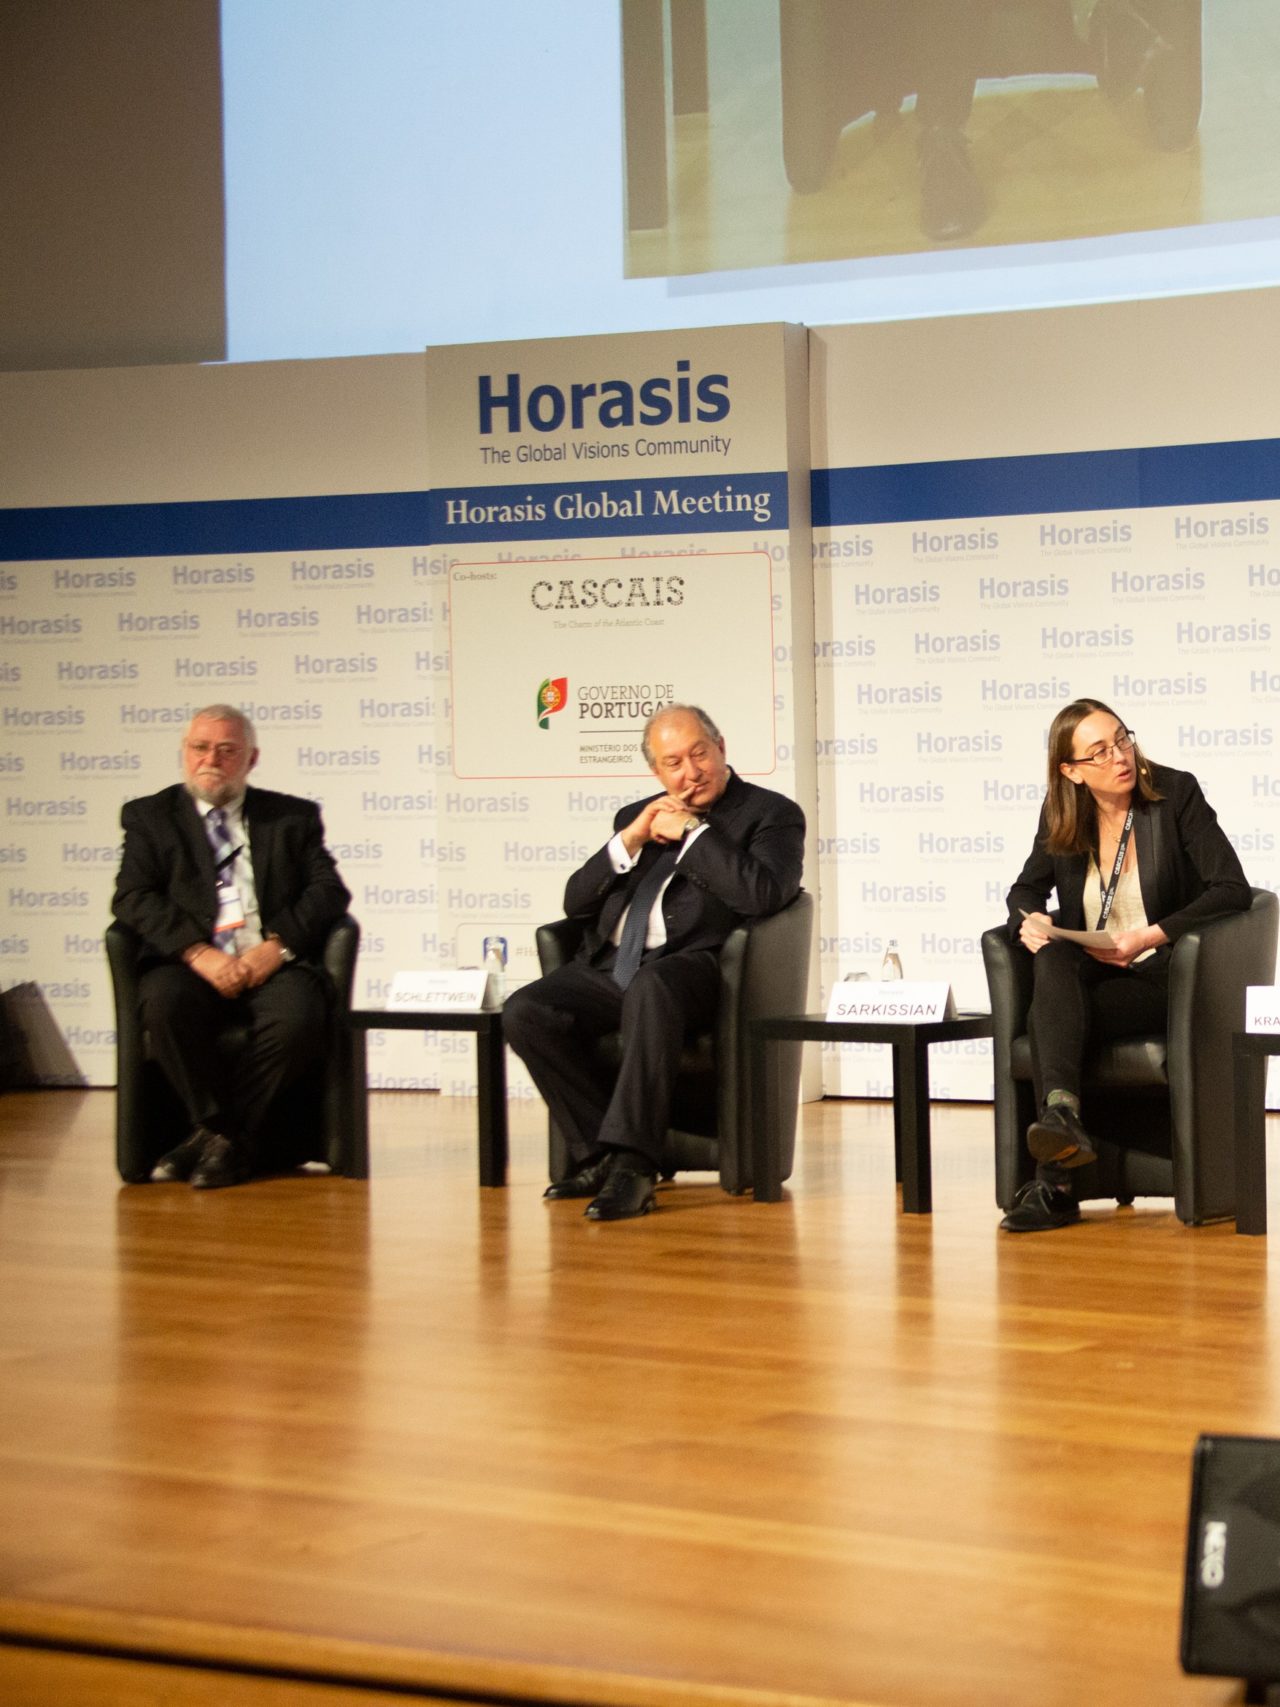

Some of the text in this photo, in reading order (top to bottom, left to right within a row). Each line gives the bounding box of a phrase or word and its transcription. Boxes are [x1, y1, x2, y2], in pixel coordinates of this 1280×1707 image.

[478, 360, 731, 434] Horasis
[480, 435, 732, 464] The Global Visions Community
[446, 486, 771, 525] Horasis Global Meeting
[1040, 521, 1132, 546] Horasis
[1174, 513, 1269, 539] Horasis
[912, 529, 999, 553] Horasis
[54, 571, 136, 589] Horasis
[173, 567, 255, 585] Horasis
[291, 562, 375, 580] Horasis
[453, 571, 497, 582] Co-hosts:
[1111, 567, 1205, 593] Horasis
[530, 575, 685, 611] CASCAIS
[854, 580, 940, 605] Horasis
[979, 574, 1069, 599] Horasis
[118, 610, 200, 631] Horasis
[237, 606, 320, 628] Horasis
[356, 599, 433, 624] Horasi
[0, 613, 82, 635] Horasis
[1176, 618, 1271, 644] Horasis
[914, 629, 1001, 654] Horasis
[1041, 623, 1134, 649] Horasis
[57, 659, 139, 680] Horasis
[175, 656, 258, 677] Horasis
[294, 652, 378, 674] Horasis
[578, 684, 674, 700] GOVERNO DE
[857, 681, 942, 705] Horasis
[981, 676, 1070, 700] Horasis
[1113, 672, 1207, 696] Horasis
[2, 705, 85, 726] Horasis
[240, 701, 322, 721] Horasis
[359, 695, 434, 718] Horasi
[578, 701, 674, 719] PORTUGA
[816, 733, 878, 755] orasis
[917, 729, 1002, 753] Horasis
[1178, 722, 1273, 747] Horasis
[297, 745, 381, 766] Horasis
[623, 744, 638, 752] DOS
[60, 750, 141, 771] Horasis
[580, 755, 633, 764] ESTRANGEIROS
[362, 788, 437, 813] Horasi
[859, 780, 944, 803] Horasis
[983, 780, 1047, 801] Horas
[6, 796, 87, 816] Horasis
[446, 791, 530, 813] Horasis
[504, 839, 588, 863] Horasis
[817, 832, 881, 854] orasis
[919, 831, 1005, 853] Horasis
[8, 887, 89, 908] Horasis
[366, 883, 438, 909] Horasi
[448, 887, 531, 909] Horasis
[862, 880, 946, 903] Horasis
[819, 931, 883, 953] orasis
[836, 1003, 938, 1016] SARKISSIAN
